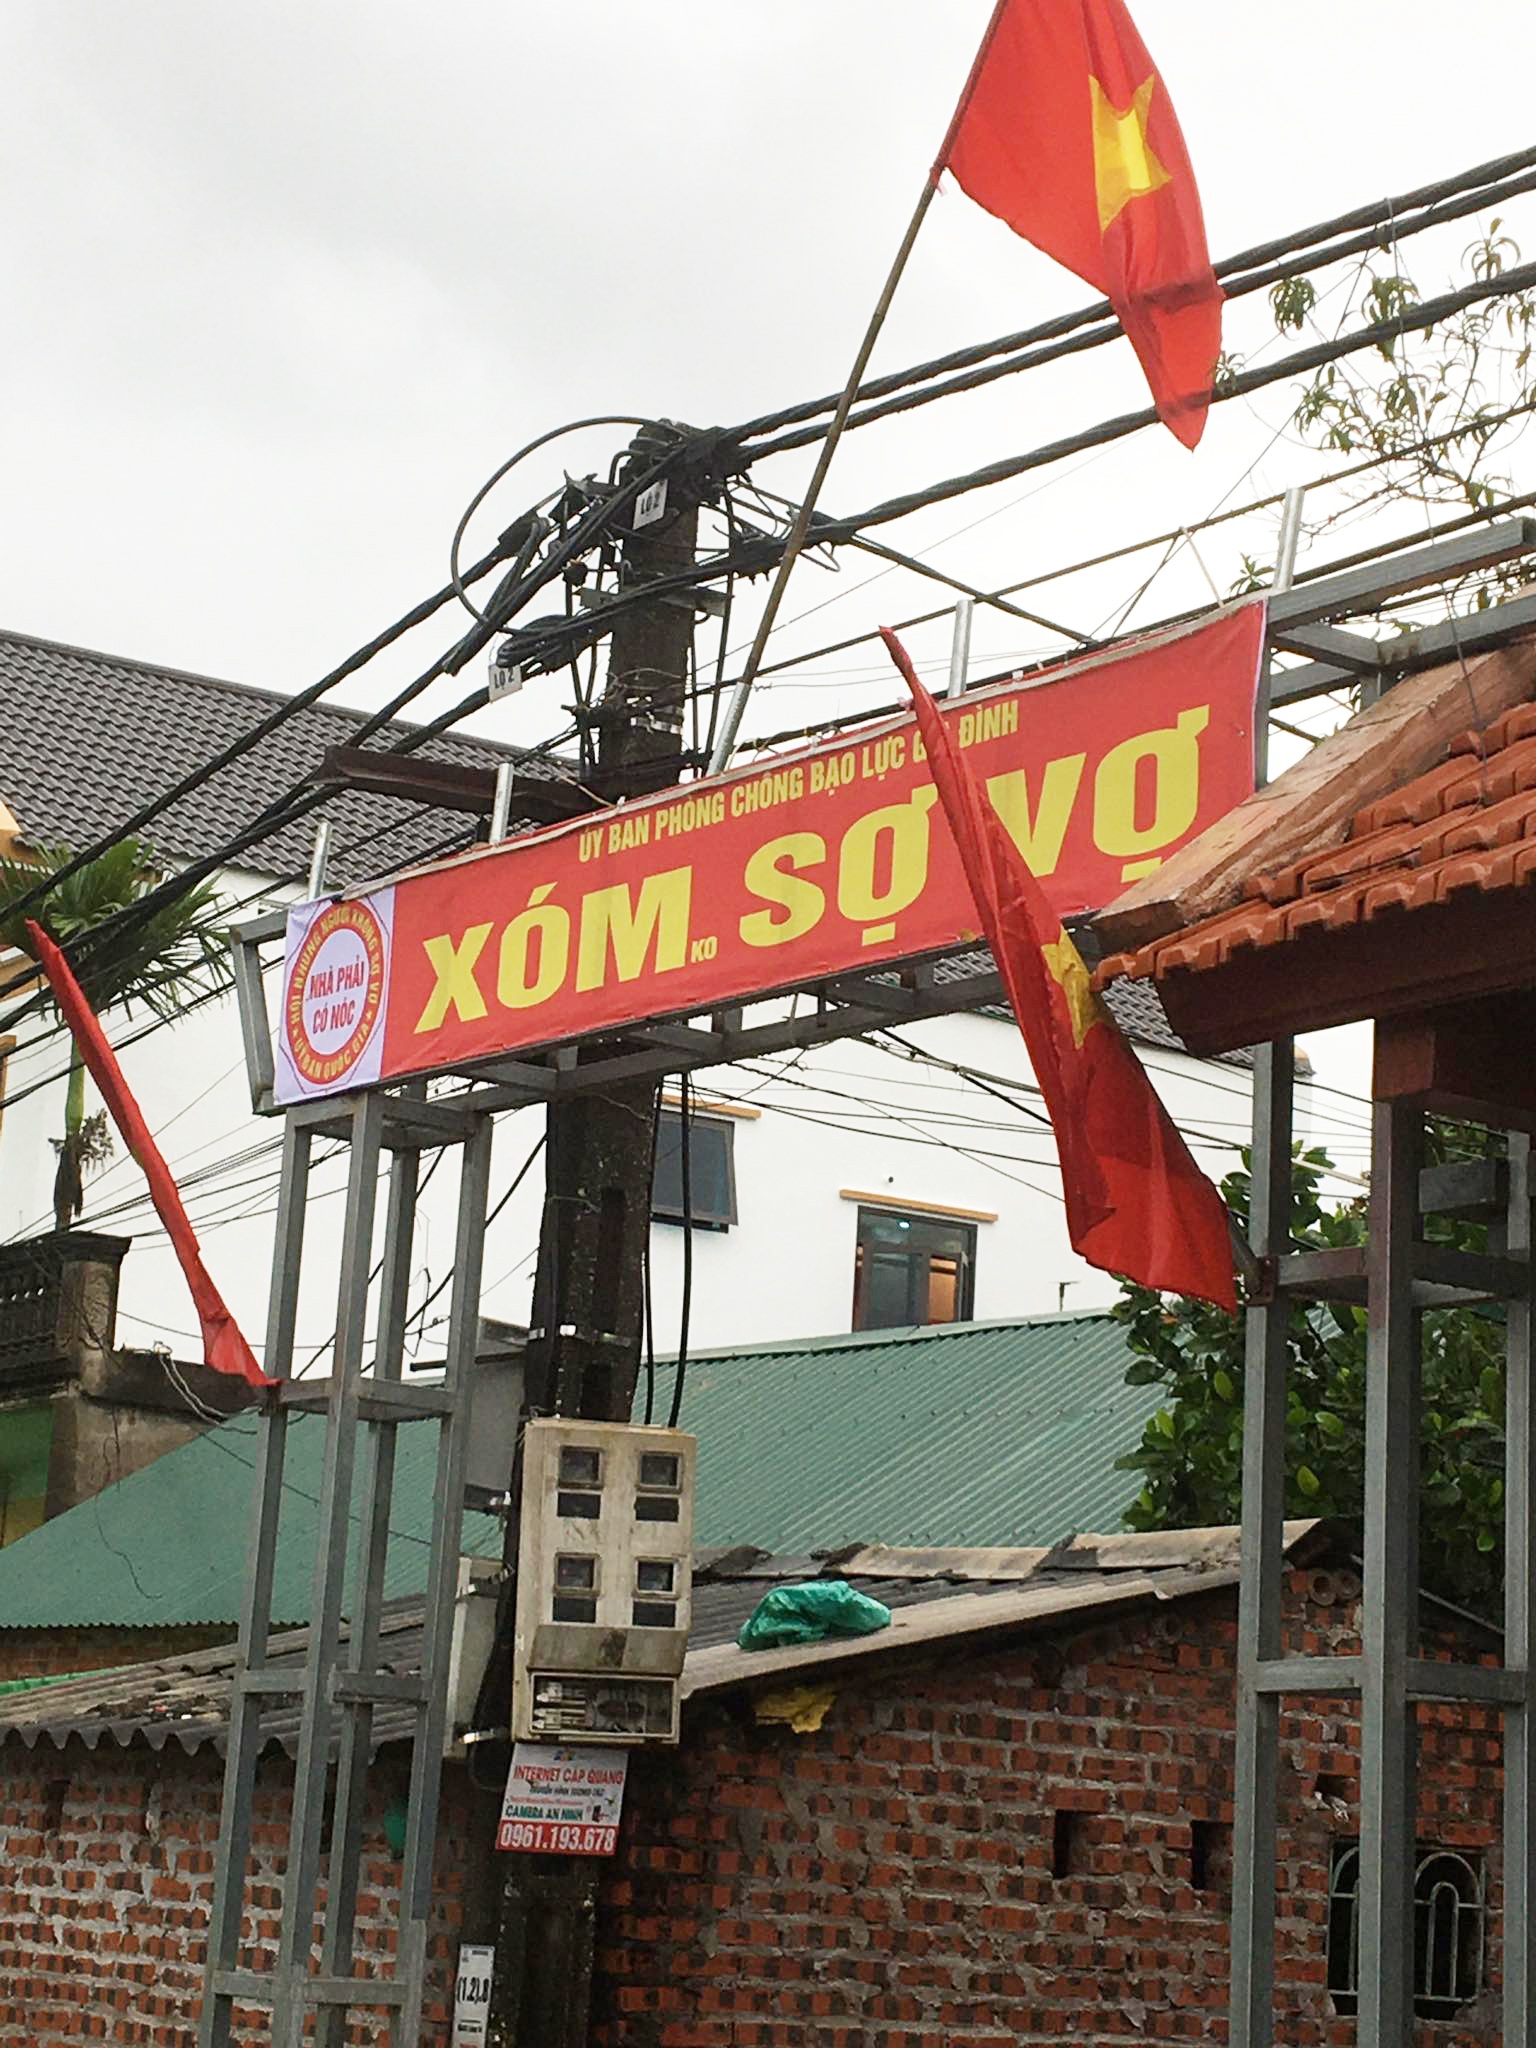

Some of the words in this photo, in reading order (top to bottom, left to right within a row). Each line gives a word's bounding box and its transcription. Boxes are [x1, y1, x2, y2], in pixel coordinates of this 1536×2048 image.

[608, 814, 650, 854] BAN
[655, 791, 725, 841] PHÒNG
[810, 751, 856, 796] BẠO
[862, 735, 905, 781] LỰC
[958, 699, 1018, 749] ĐÌNH
[414, 866, 692, 1034] XÓM
[691, 936, 718, 963] KO
[739, 783, 939, 948] SỢ
[986, 704, 1210, 883] VỢ
[313, 1002, 328, 1034] CÓ
[513, 1765, 561, 1782] INTERNET
[501, 1823, 616, 1851] 0961.193.678
